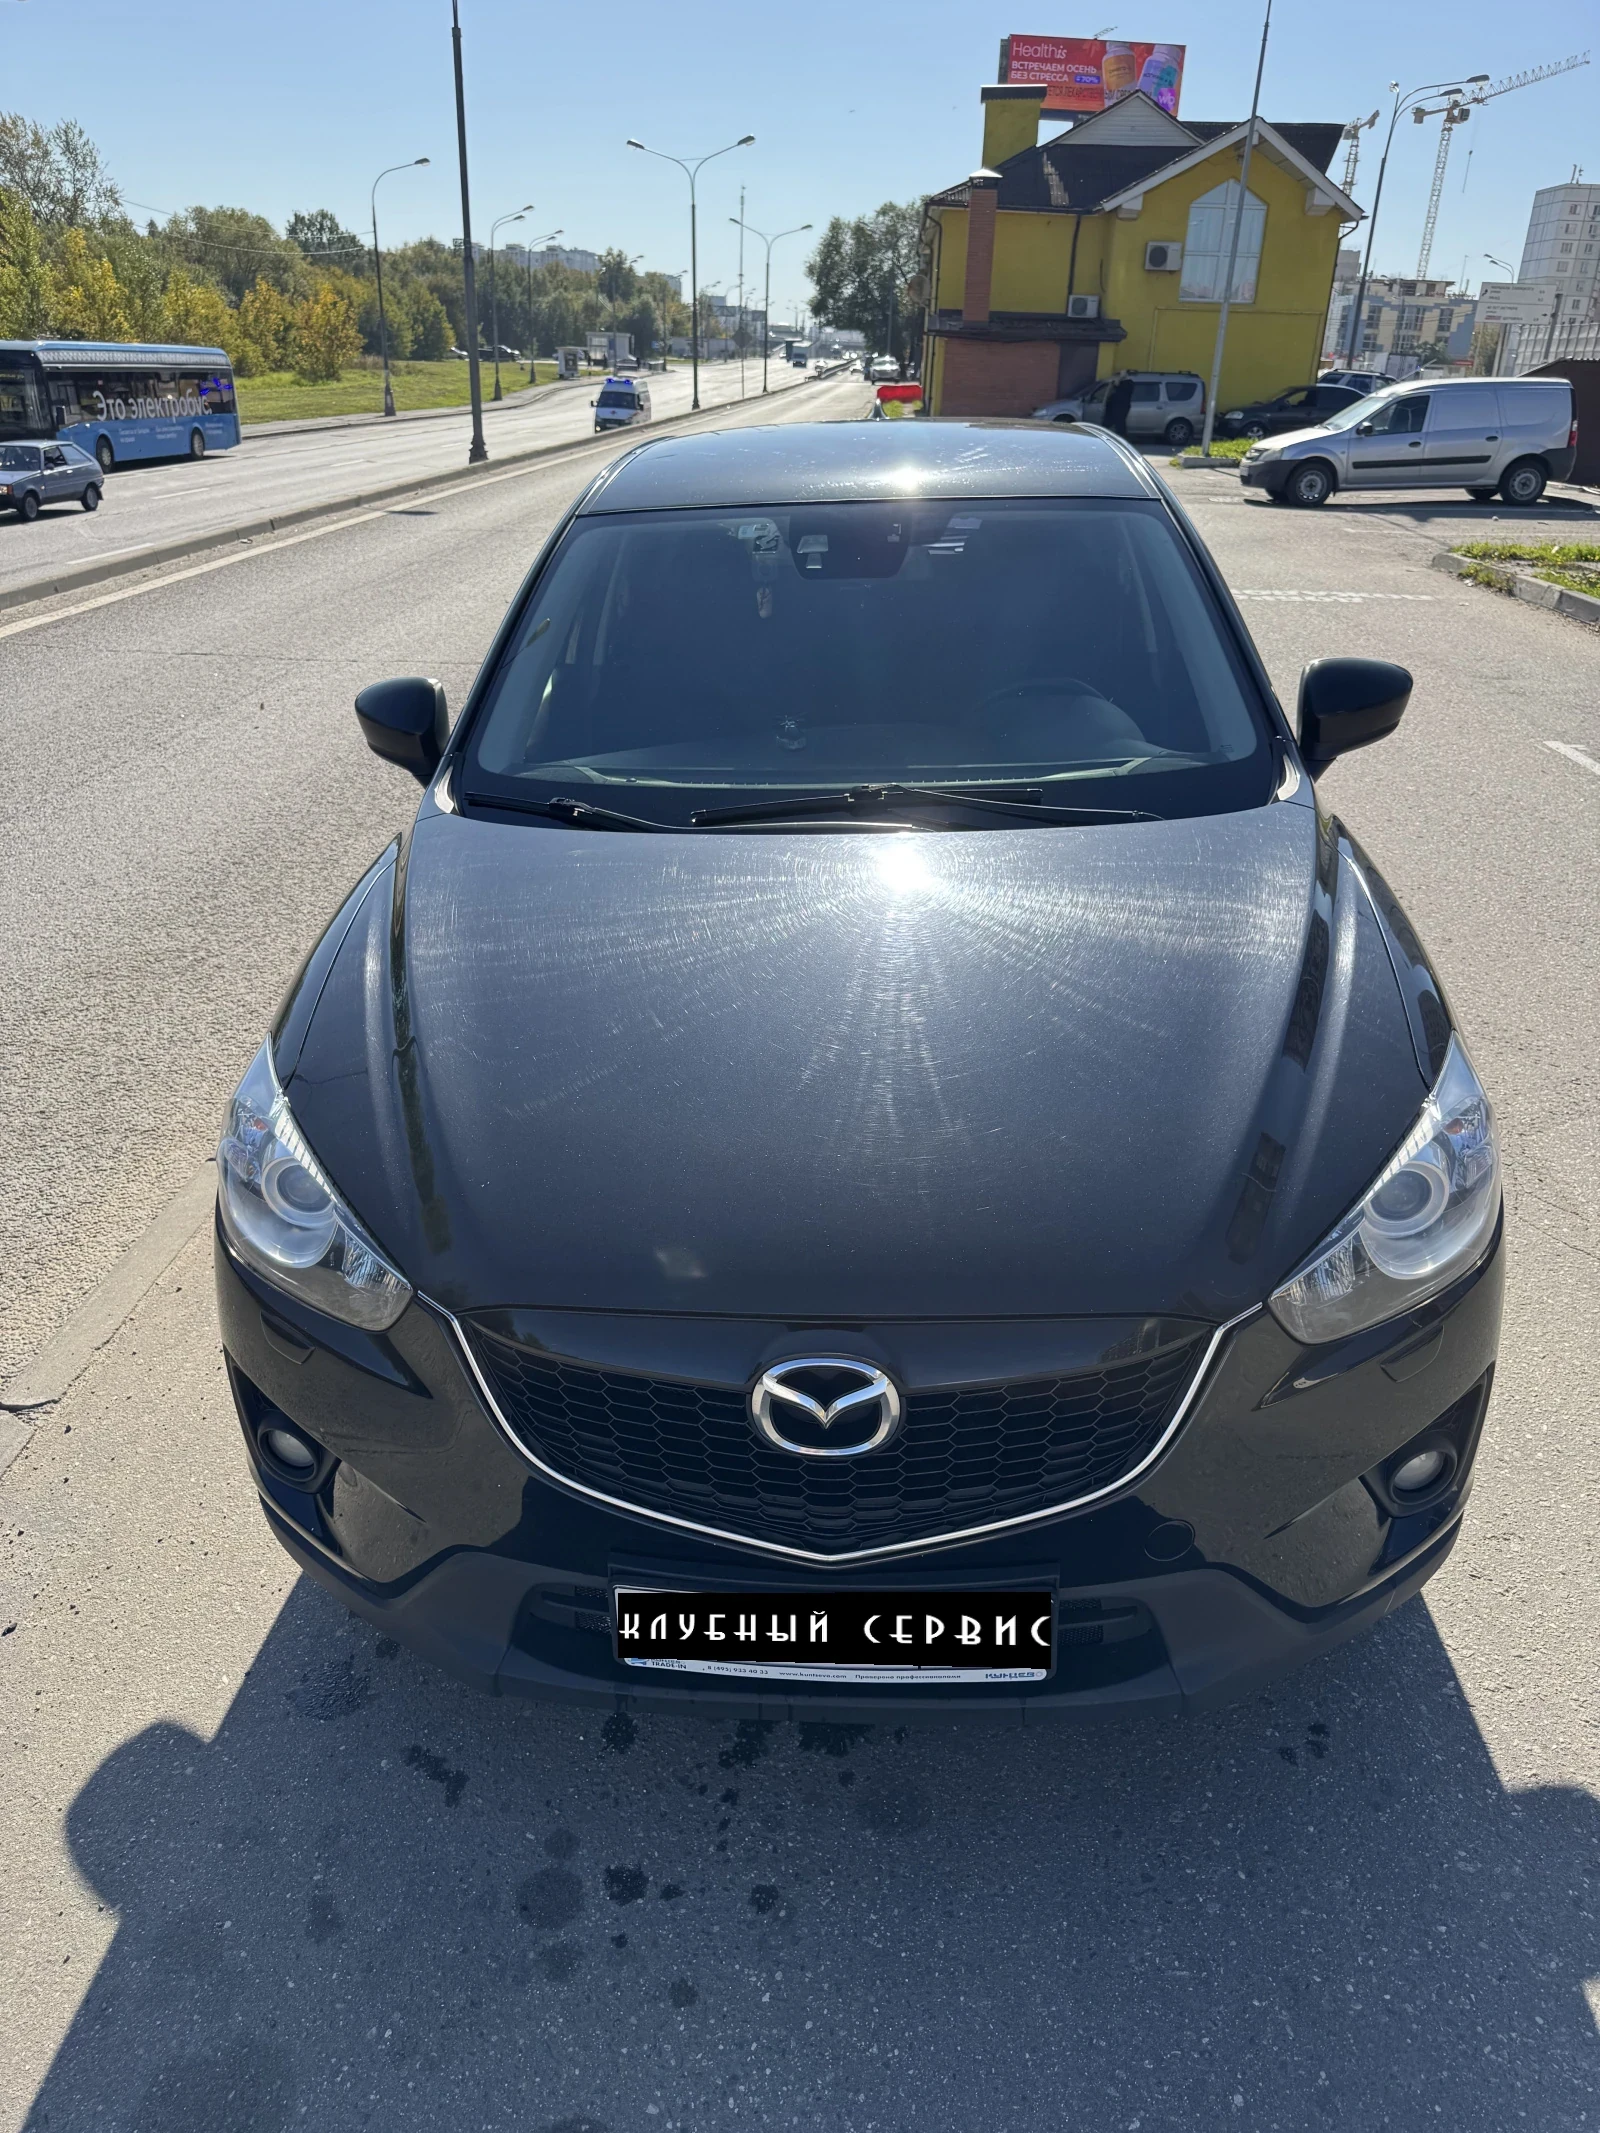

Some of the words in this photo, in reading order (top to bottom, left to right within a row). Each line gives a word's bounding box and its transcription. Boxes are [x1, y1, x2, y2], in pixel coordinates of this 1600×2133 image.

[1012, 42, 1067, 59] Healthis
[1011, 61, 1065, 73] ВСТРЕЧАЕМ
[1066, 64, 1097, 74] ОСЕНЬ
[1010, 71, 1028, 80] БЕЗ
[1028, 72, 1069, 82] СТРЕССА
[92, 390, 126, 421] Это
[652, 1661, 687, 1670] TRADE-IN
